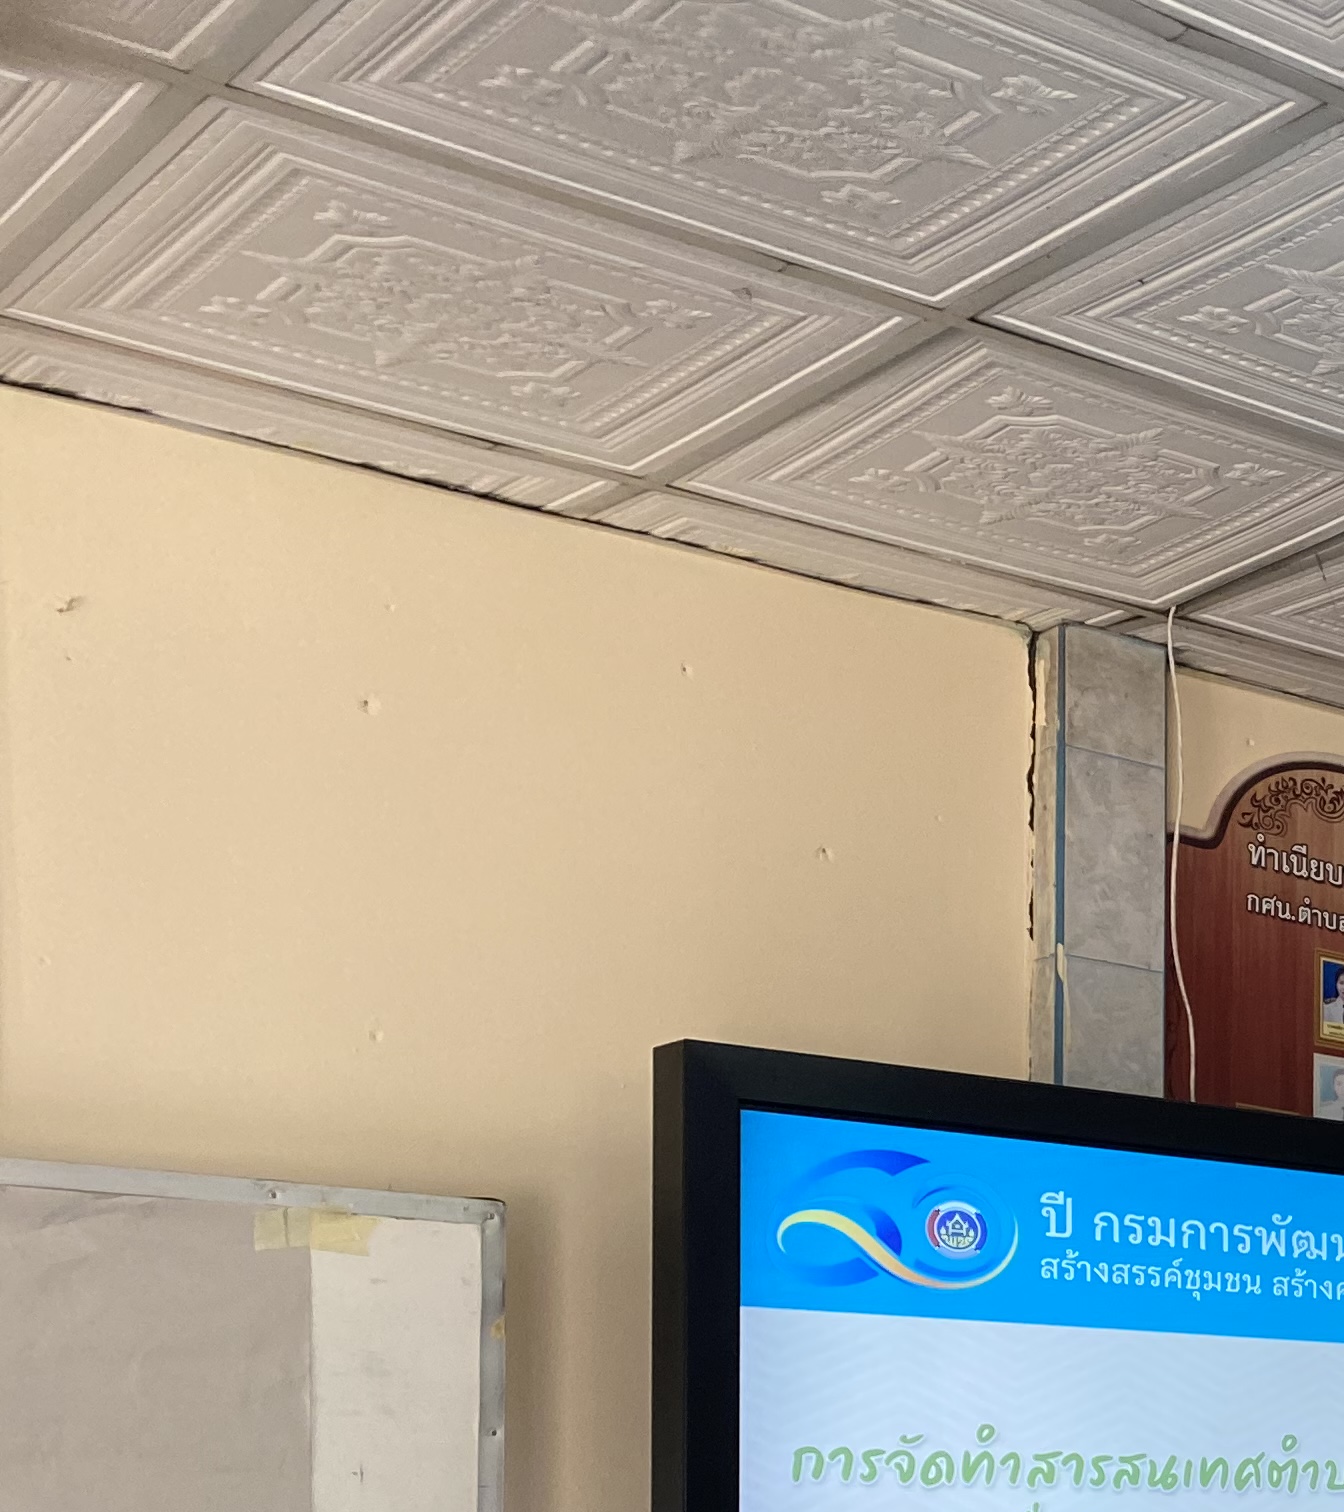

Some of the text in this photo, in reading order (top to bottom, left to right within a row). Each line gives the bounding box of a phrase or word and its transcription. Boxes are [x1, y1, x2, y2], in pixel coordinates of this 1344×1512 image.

[1039, 1190, 1073, 1239] ปี
[1040, 1249, 1262, 1300] สร้างสรรค์ชุมชน
